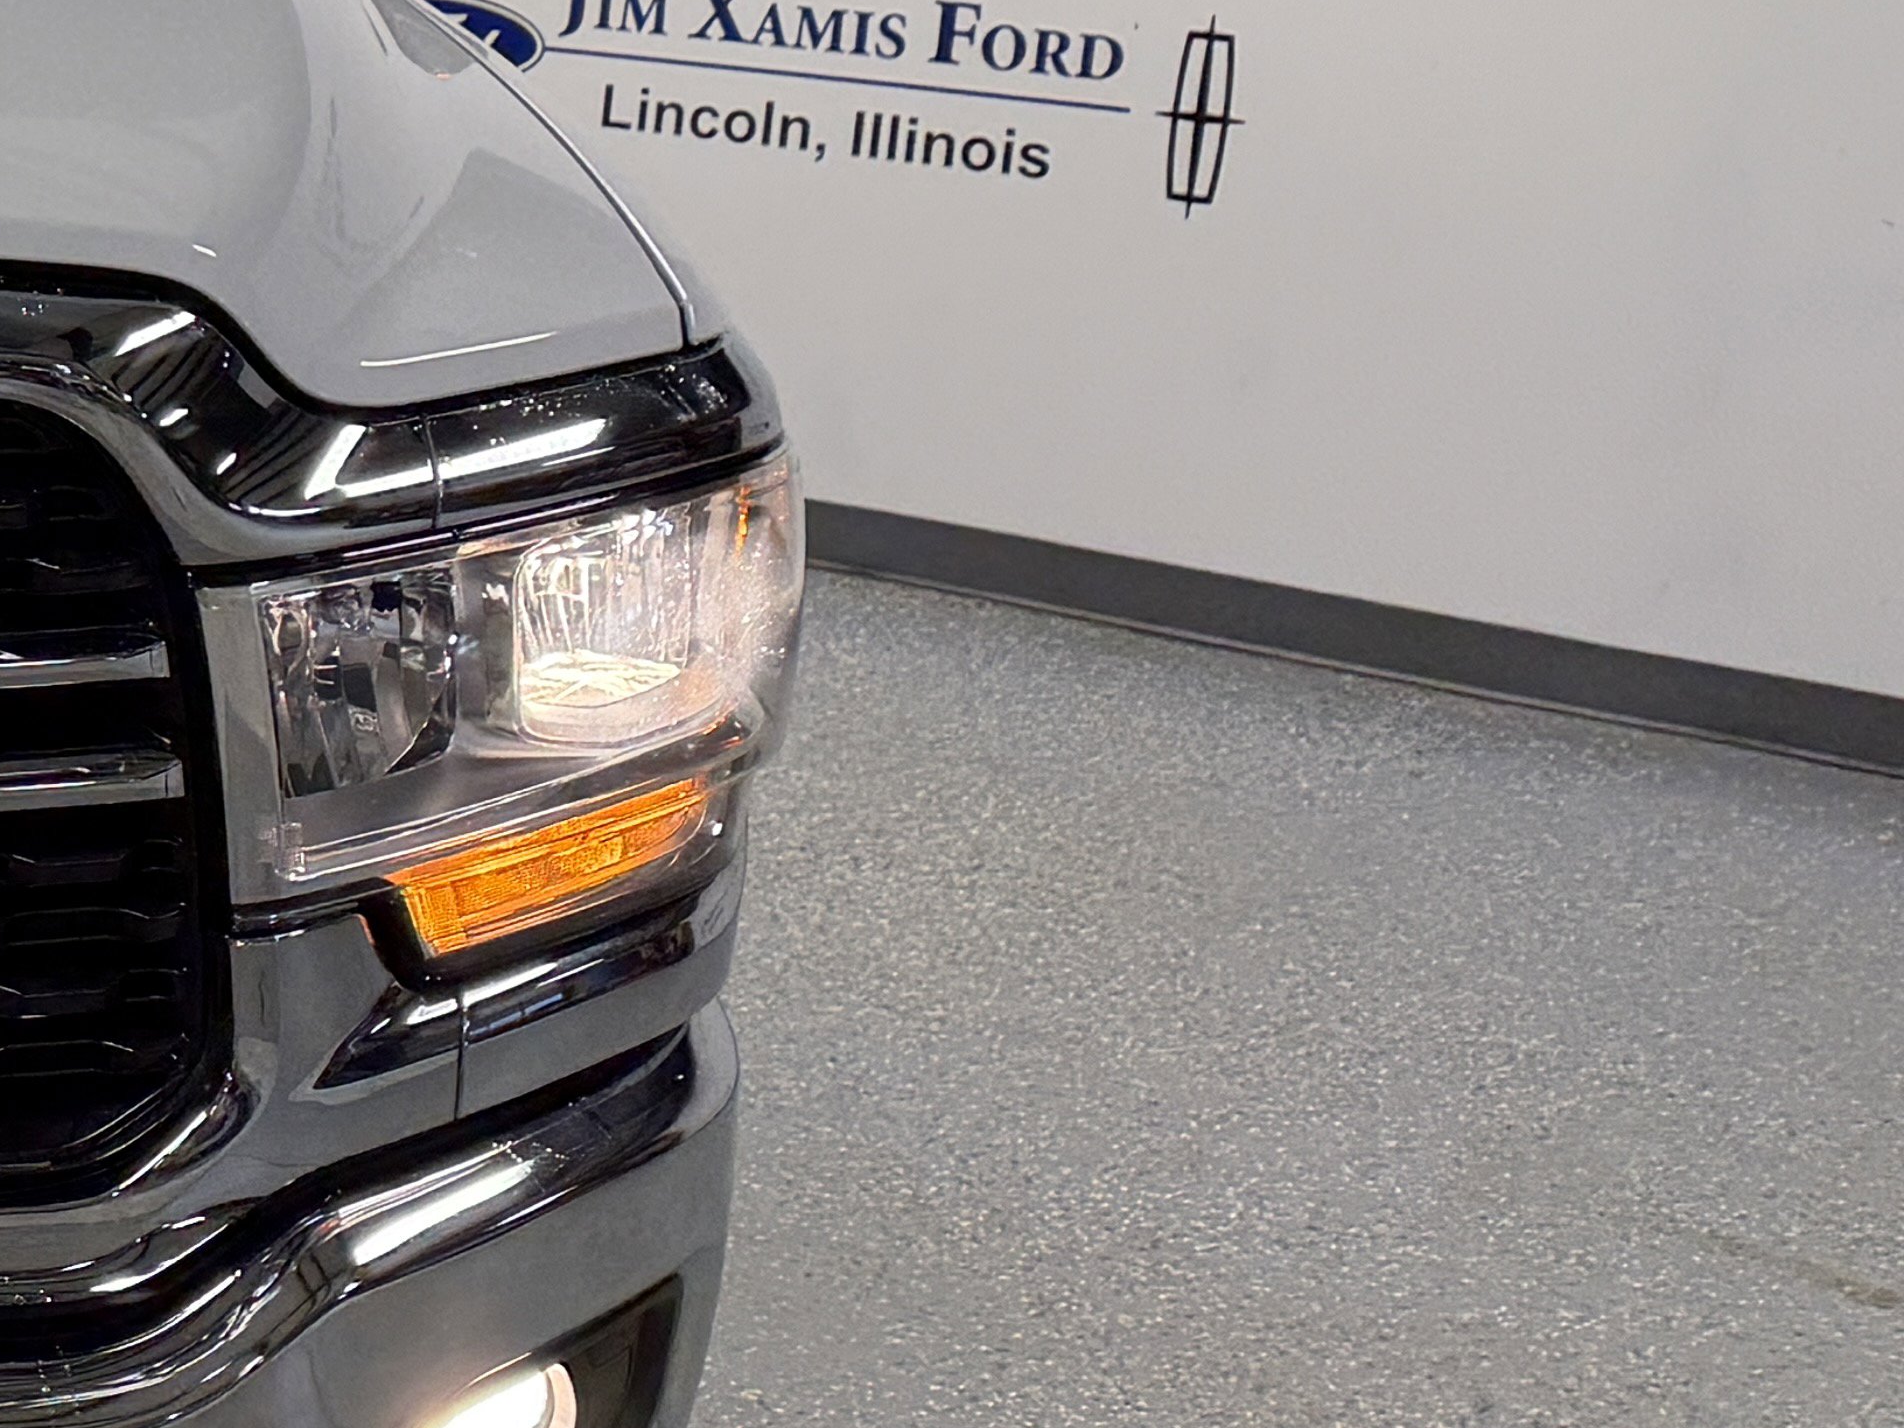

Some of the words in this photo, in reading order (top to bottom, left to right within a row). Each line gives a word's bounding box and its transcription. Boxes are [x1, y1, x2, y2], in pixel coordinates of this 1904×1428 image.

[929, 1, 1123, 79] FORD
[602, 85, 825, 161] Lincoln,
[852, 112, 1049, 178] Illinois
